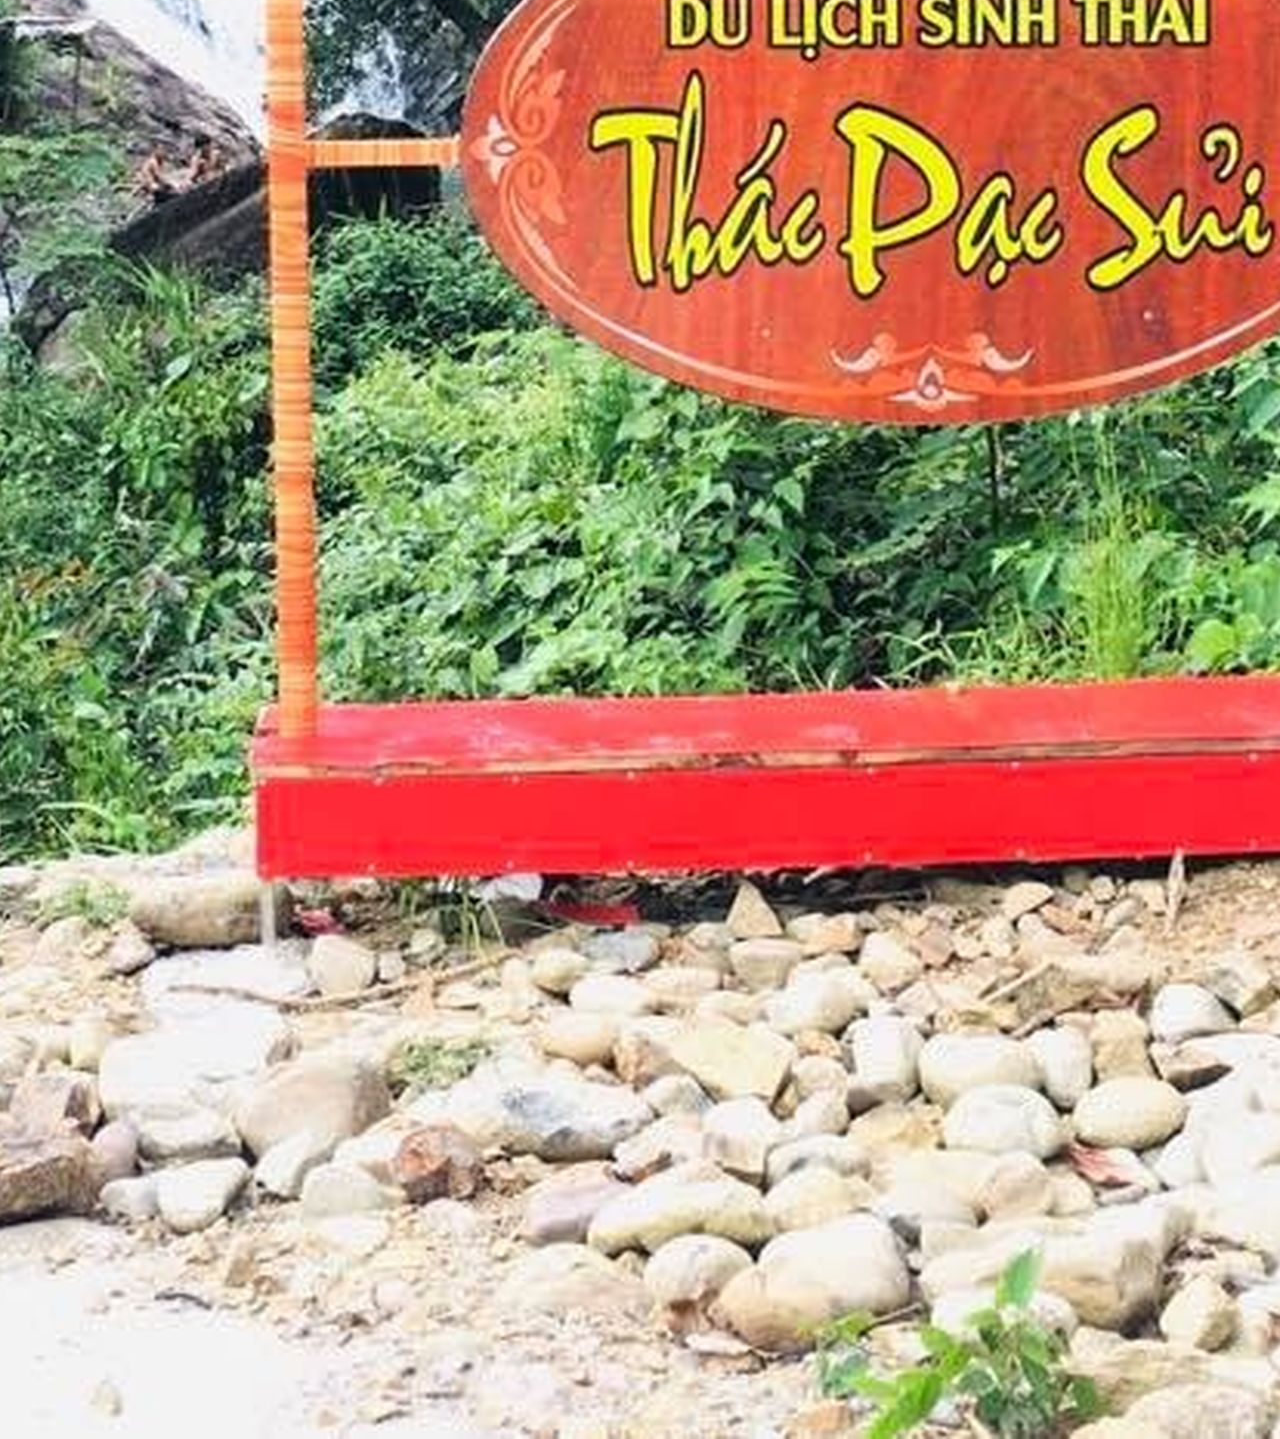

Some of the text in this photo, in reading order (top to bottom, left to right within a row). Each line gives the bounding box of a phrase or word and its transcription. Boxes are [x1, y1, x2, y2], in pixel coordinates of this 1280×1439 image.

[589, 71, 1272, 297] Thác Pạc Sủi
